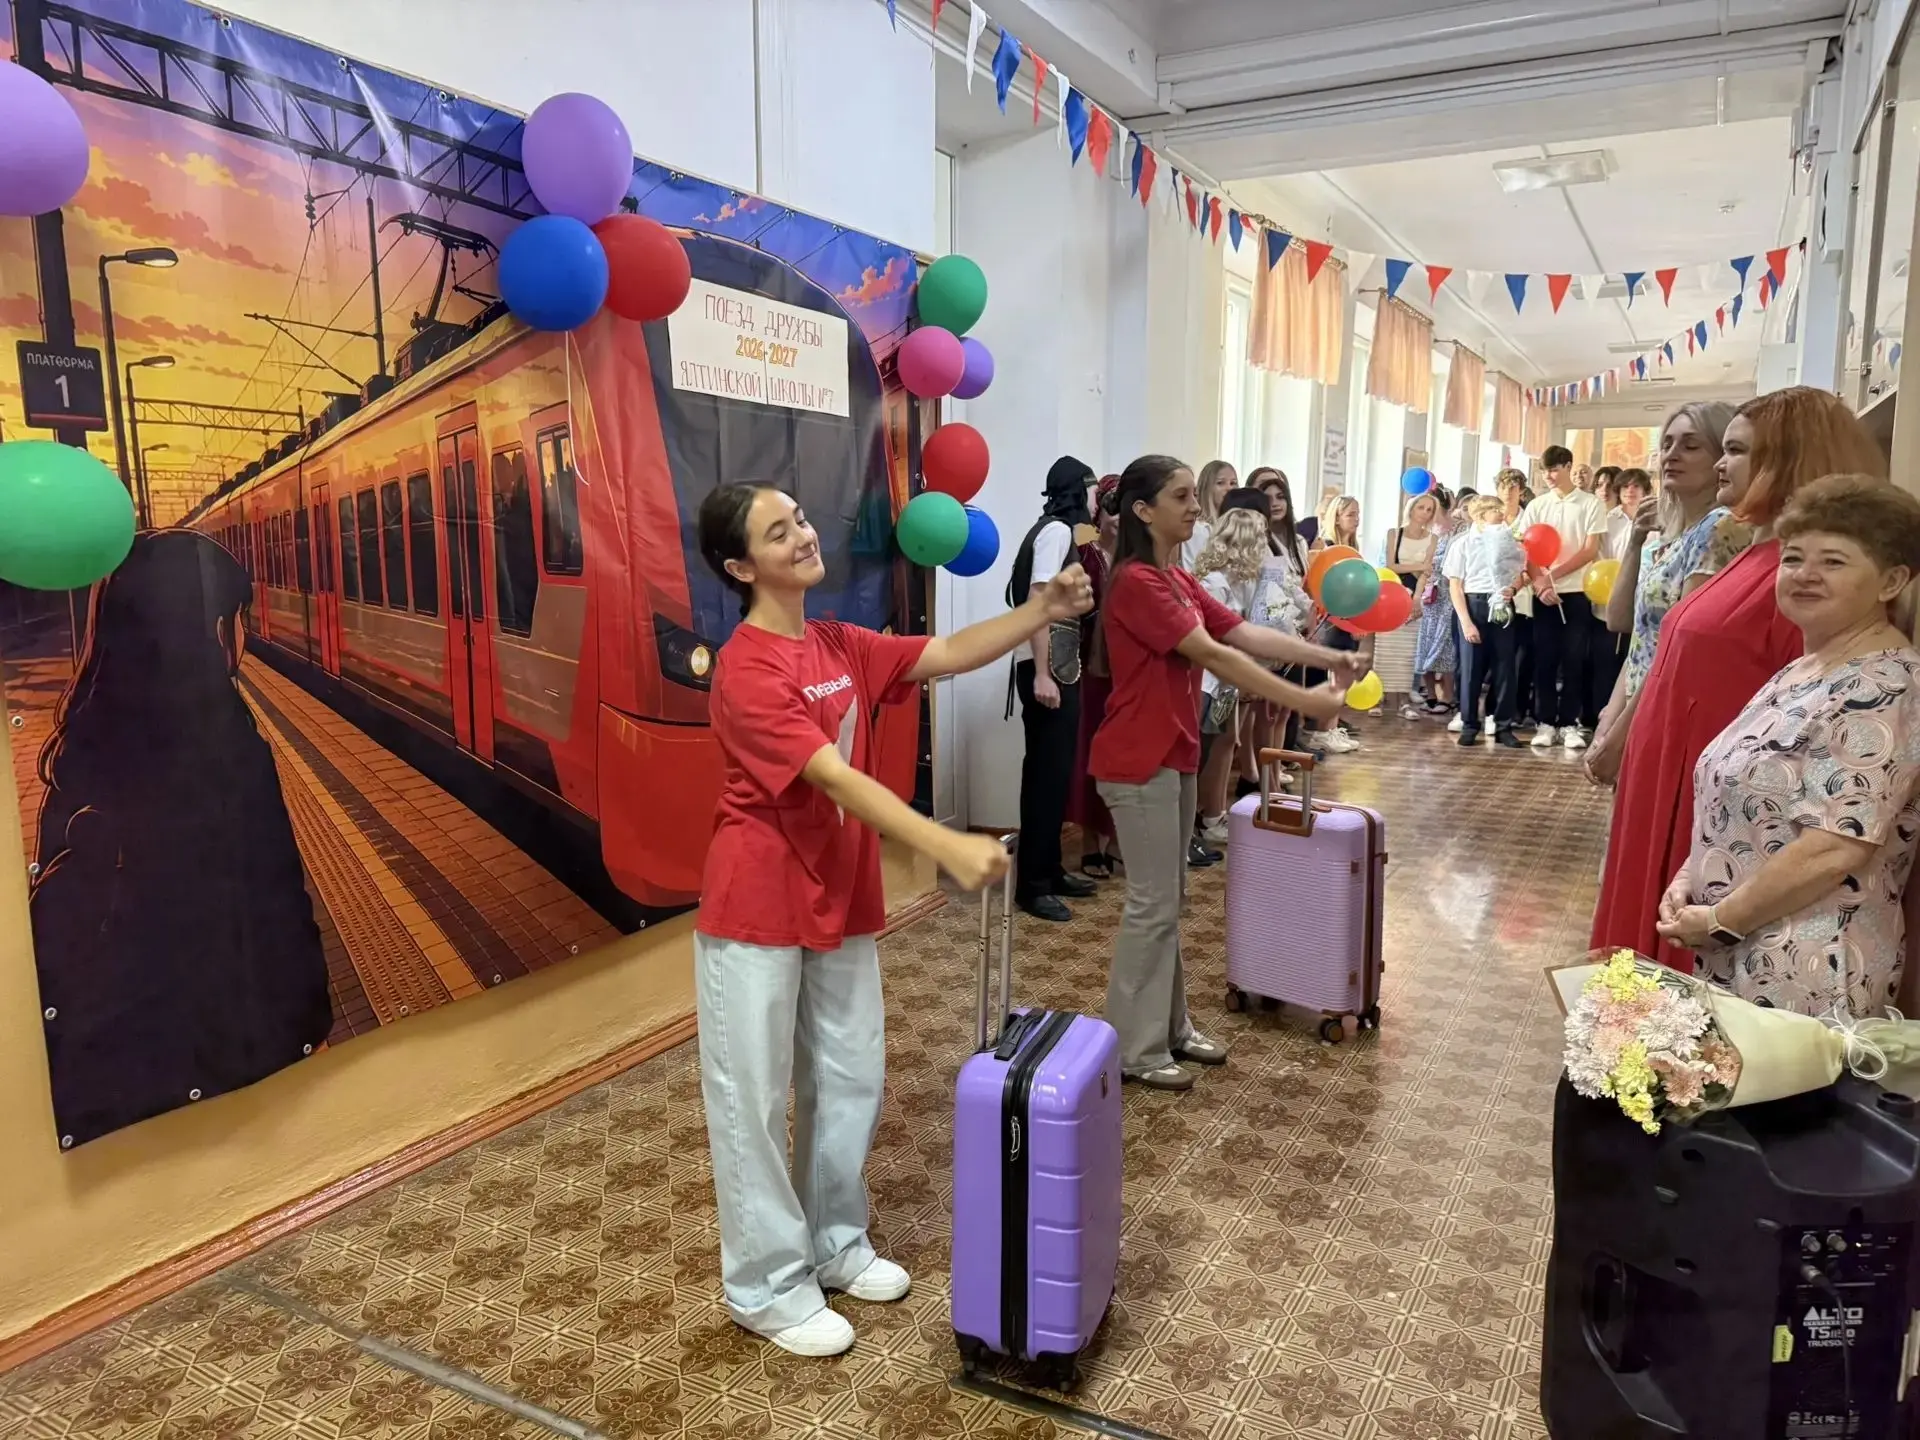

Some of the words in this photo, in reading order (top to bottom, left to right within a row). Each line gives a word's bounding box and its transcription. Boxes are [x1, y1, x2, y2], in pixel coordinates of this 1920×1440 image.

[704, 294, 755, 332] ПОЕЗД
[764, 310, 823, 348] ДРУЖБЫ
[26, 352, 95, 370] ПЛАТФОРМА
[54, 374, 70, 408] 1
[680, 360, 762, 398] ЯЛТИНСКОЙ
[770, 376, 815, 408] ШКОЛЫ
[1803, 1306, 1864, 1320] ALTO
[1807, 1339, 1855, 1348] TRUESOC
